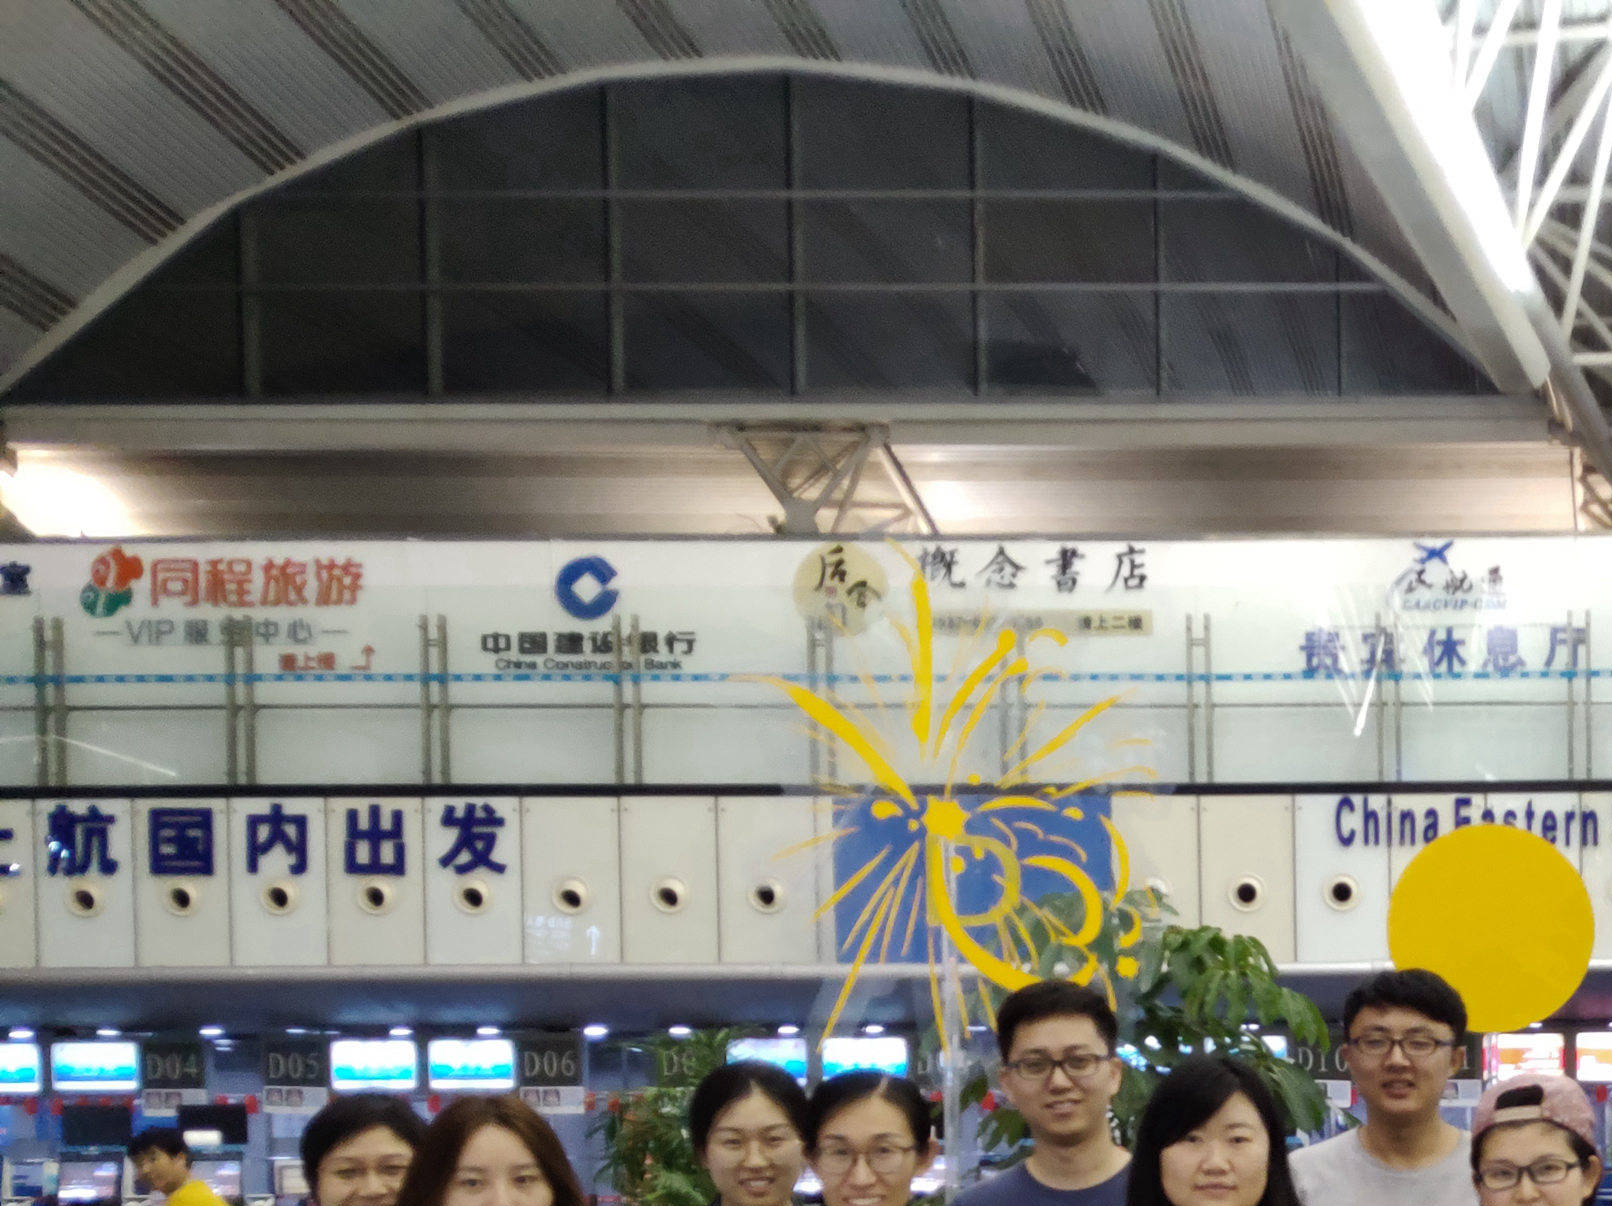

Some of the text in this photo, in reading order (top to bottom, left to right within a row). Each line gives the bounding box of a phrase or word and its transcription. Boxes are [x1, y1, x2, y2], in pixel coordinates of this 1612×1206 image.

[150, 556, 363, 607] 同程旅游
[495, 657, 537, 671] China
[1335, 796, 1439, 847] China
[524, 1051, 577, 1078] D06
